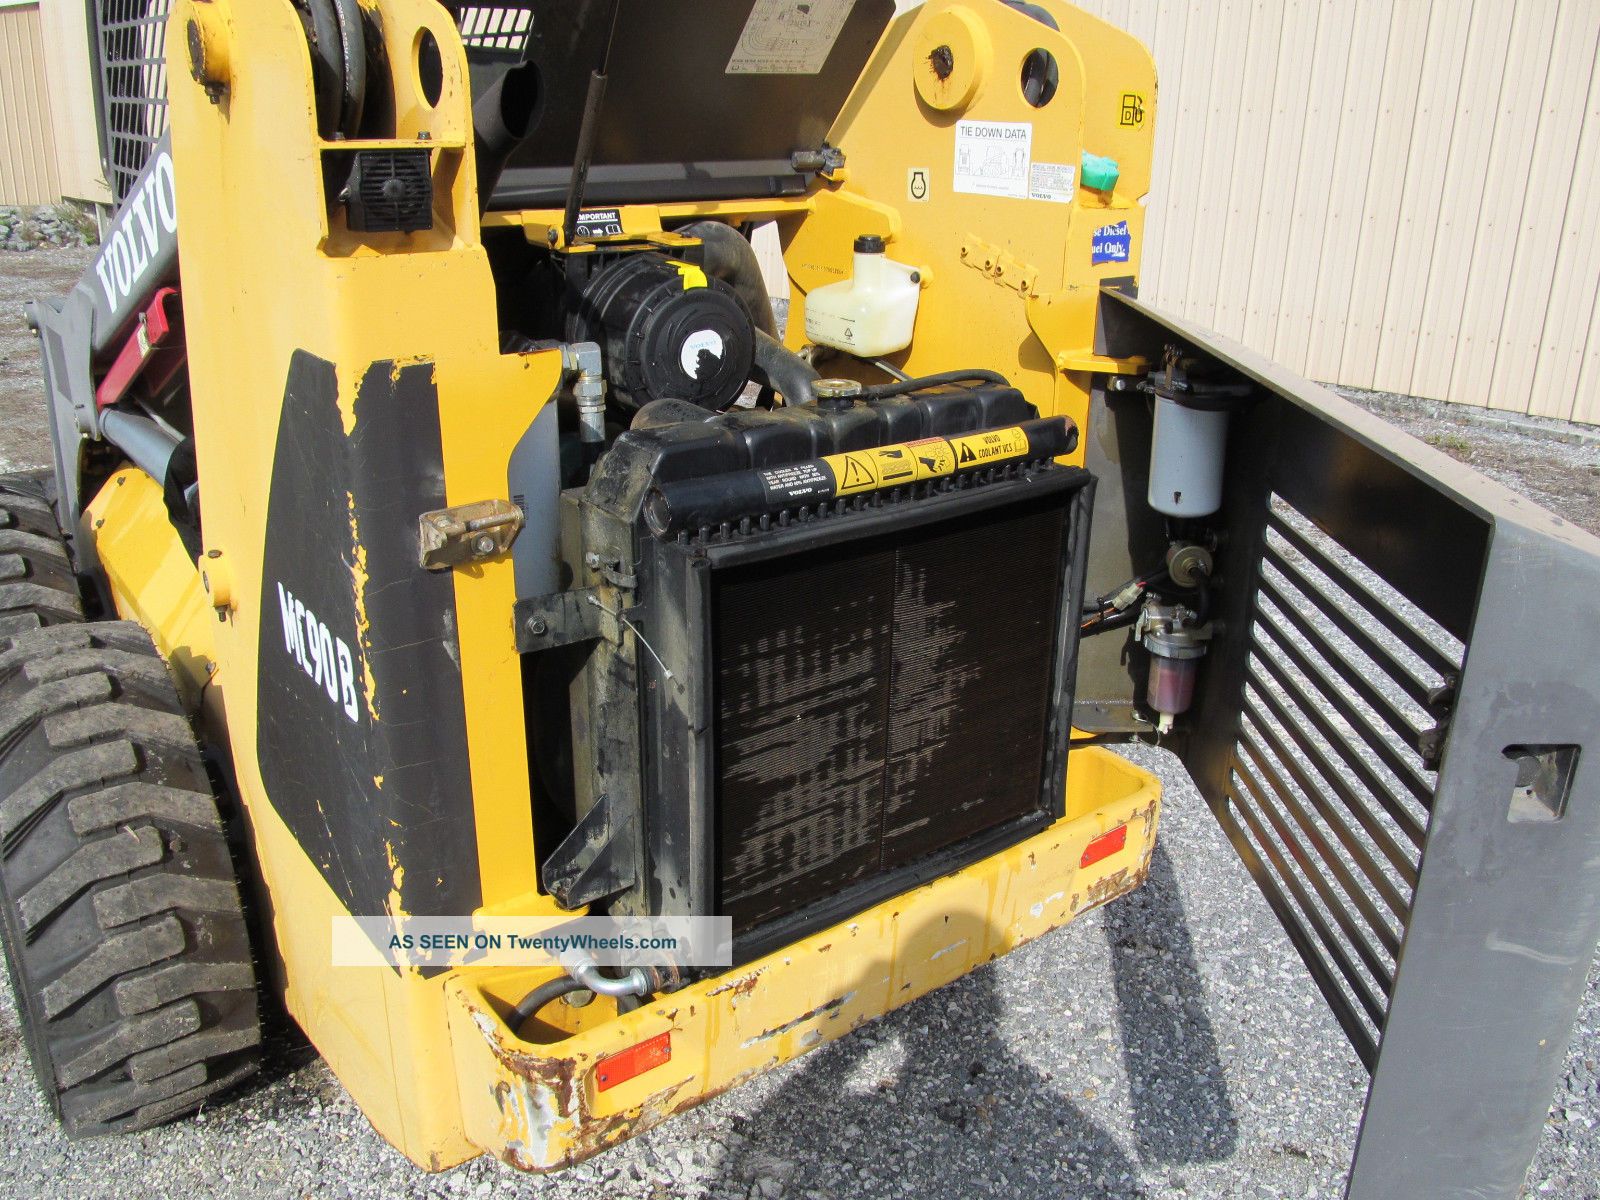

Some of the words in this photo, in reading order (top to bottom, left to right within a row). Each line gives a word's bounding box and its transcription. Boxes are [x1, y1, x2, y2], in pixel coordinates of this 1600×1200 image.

[960, 125, 973, 137] TIE
[975, 127, 1003, 139] DOWN
[1004, 128, 1027, 140] DATA
[96, 151, 177, 314] VOLVO
[982, 435, 1000, 444] VOLVO
[978, 444, 1002, 459] COOLANT
[789, 488, 812, 496] VOLVO
[277, 581, 359, 723] MC90B
